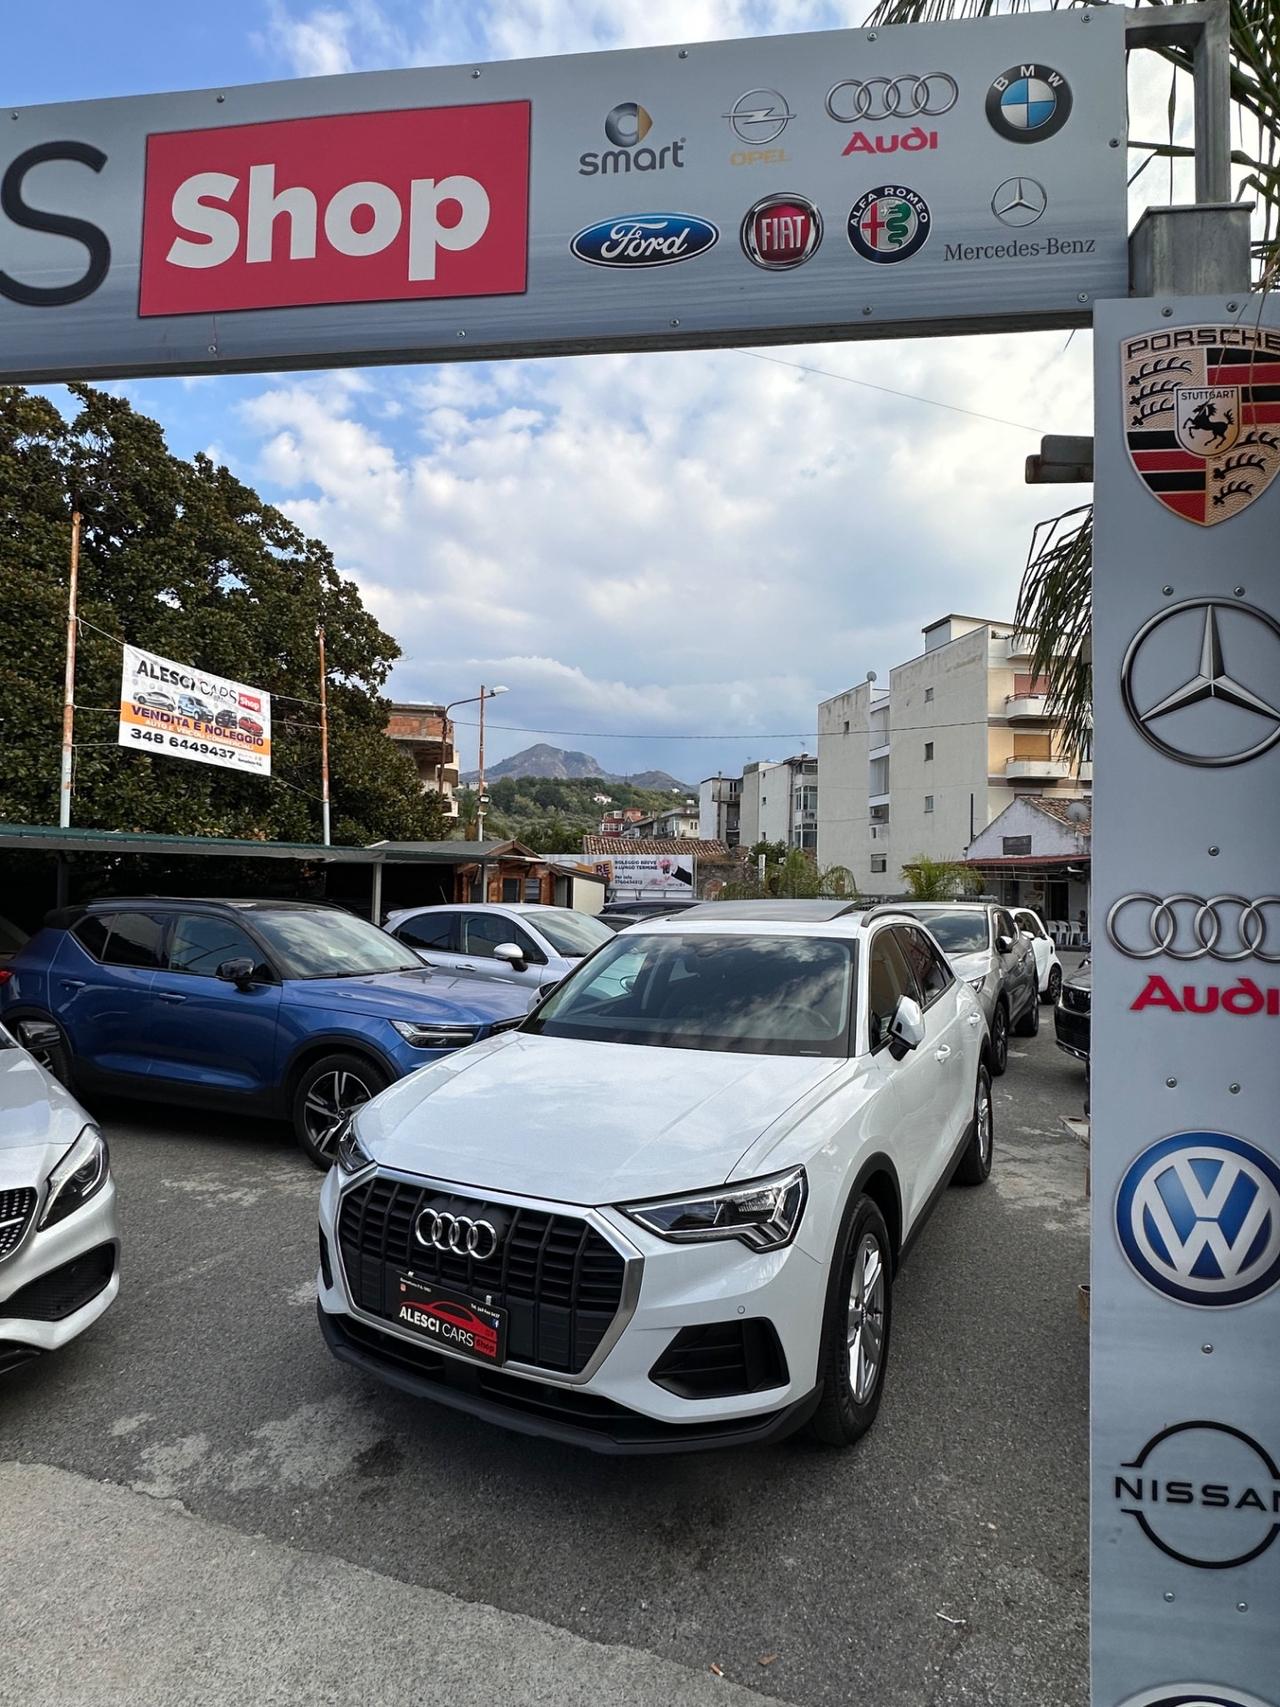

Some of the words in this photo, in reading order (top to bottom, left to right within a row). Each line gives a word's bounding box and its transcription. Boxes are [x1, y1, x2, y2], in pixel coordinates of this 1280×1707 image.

[993, 64, 1064, 92] BMW
[578, 140, 684, 177] smart
[730, 148, 792, 167] OPEL
[841, 126, 938, 156] Audi
[166, 163, 490, 282] Shop
[850, 192, 877, 227] ALFA
[884, 186, 928, 223] ROMEO
[600, 221, 691, 259] Ford
[761, 215, 806, 251] FIAT
[943, 236, 1096, 262] Mercedes-Benz
[1181, 389, 1236, 401] STUTTGART
[136, 660, 196, 691] ALESCI
[200, 681, 237, 704] CARS
[239, 696, 260, 712] Shop
[131, 705, 191, 729] VENDITA
[193, 722, 202, 731] E
[204, 724, 264, 747] NOLEGGIO
[131, 728, 165, 744] 348
[169, 737, 236, 760] 6449437
[1130, 974, 1279, 1016] Audi
[399, 1306, 440, 1333] ALESCI
[442, 1323, 474, 1347] CARS
